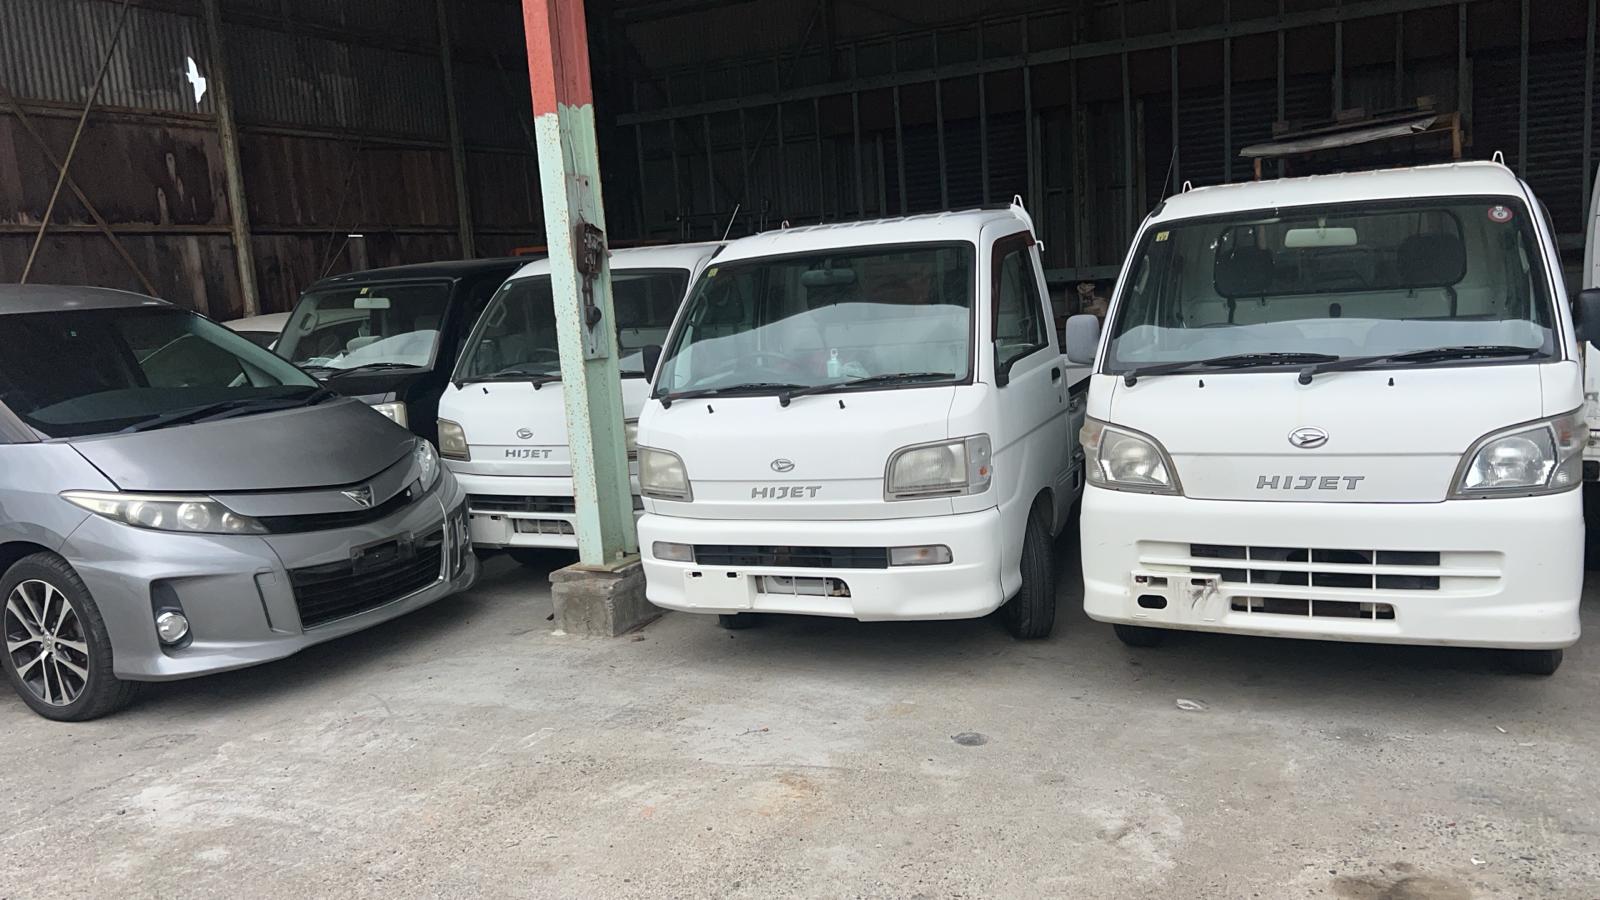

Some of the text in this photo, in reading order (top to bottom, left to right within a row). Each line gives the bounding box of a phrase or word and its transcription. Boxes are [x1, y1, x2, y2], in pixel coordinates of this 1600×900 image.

[505, 449, 553, 459] HIJET
[1256, 475, 1366, 490] HIJET
[751, 485, 822, 500] HIJET
